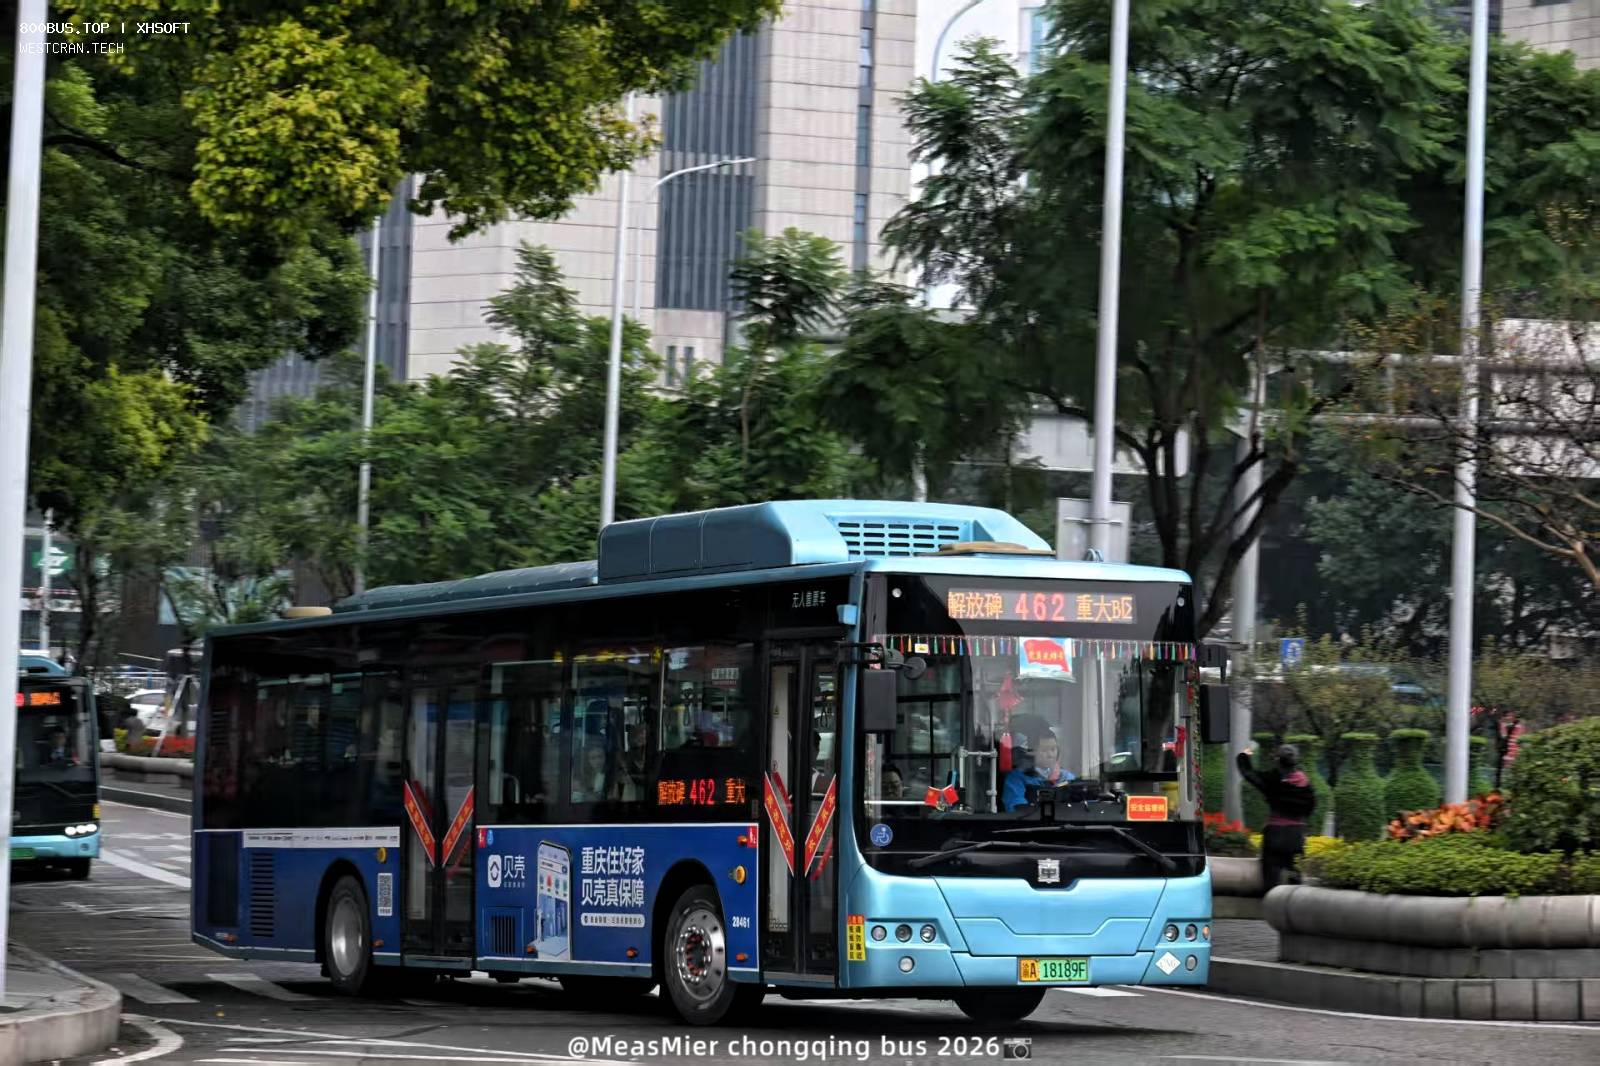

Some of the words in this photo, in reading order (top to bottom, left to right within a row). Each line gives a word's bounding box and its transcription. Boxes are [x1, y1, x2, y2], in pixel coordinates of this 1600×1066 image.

[948, 591, 1003, 620] 解放碑
[1015, 592, 1066, 622] 462
[1075, 594, 1133, 622] 重大B区
[689, 778, 715, 805] 462
[725, 778, 745, 804] 重大
[504, 854, 525, 879] 贝壳
[581, 846, 645, 875] 重庆住好家
[581, 878, 645, 907] 贝壳真保障
[731, 915, 750, 929] 28461
[1043, 962, 1085, 978] 18189F
